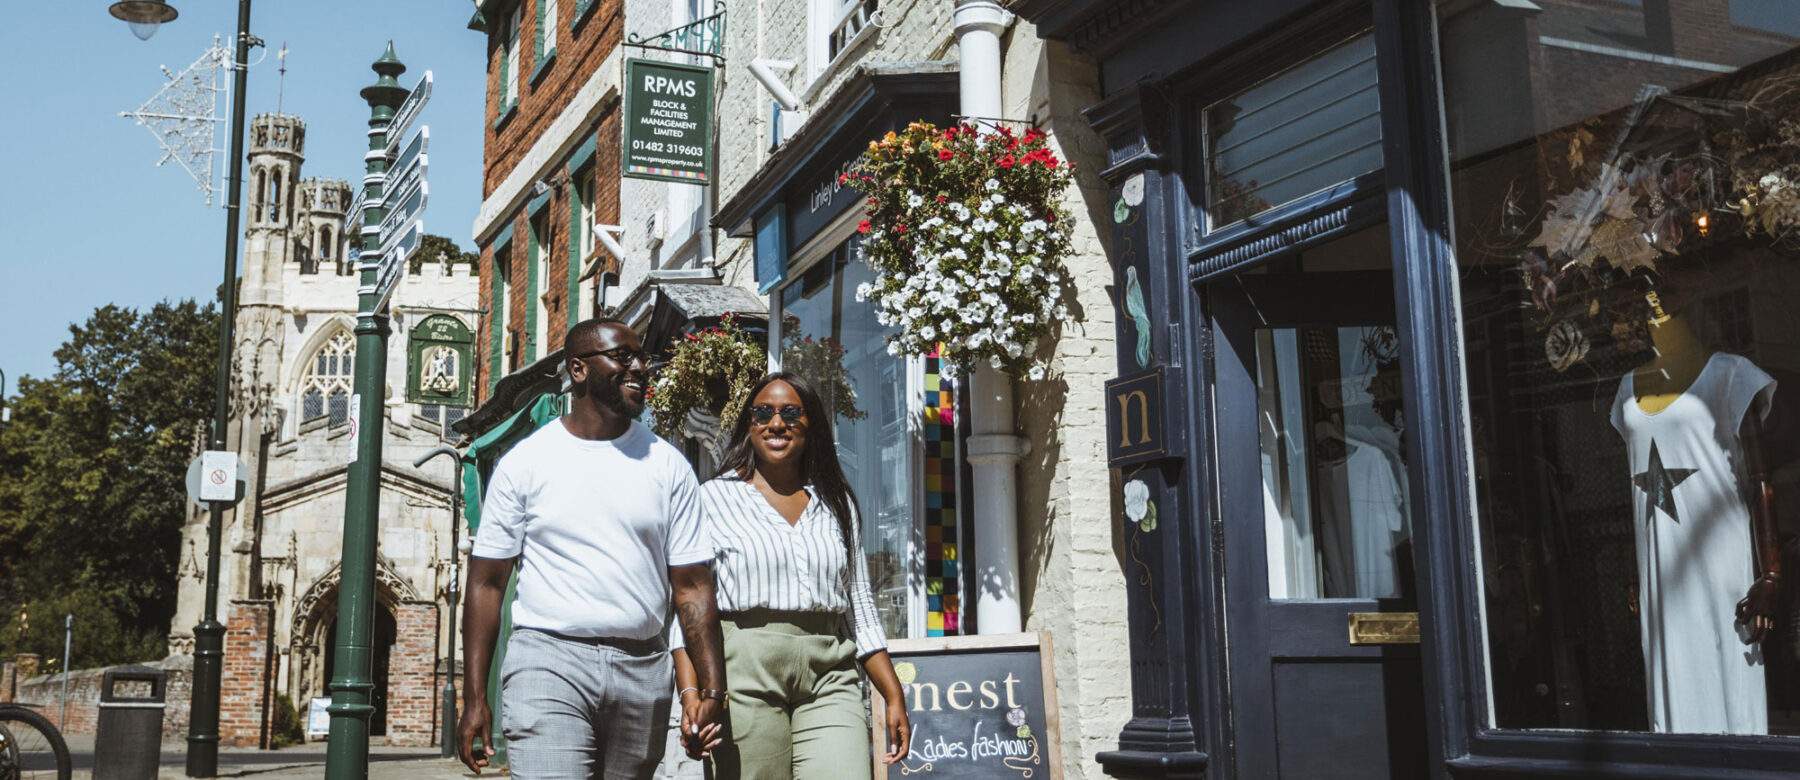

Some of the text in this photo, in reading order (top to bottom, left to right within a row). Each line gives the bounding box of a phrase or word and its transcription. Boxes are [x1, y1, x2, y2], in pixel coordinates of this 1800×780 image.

[644, 75, 696, 97] RPMS
[653, 99, 687, 110] BLOCK &
[650, 108, 688, 120] FACILITIES
[641, 117, 697, 130] MANAGEMENT
[653, 128, 683, 138] LIMITED
[632, 140, 703, 156] 01482 319603
[631, 155, 703, 167] www.rpmsproperty.co.uk
[811, 182, 833, 214] Linley
[834, 169, 841, 193] &
[1116, 390, 1152, 448] n
[911, 672, 1021, 712] nest
[907, 721, 1029, 762] Ladies fashion
